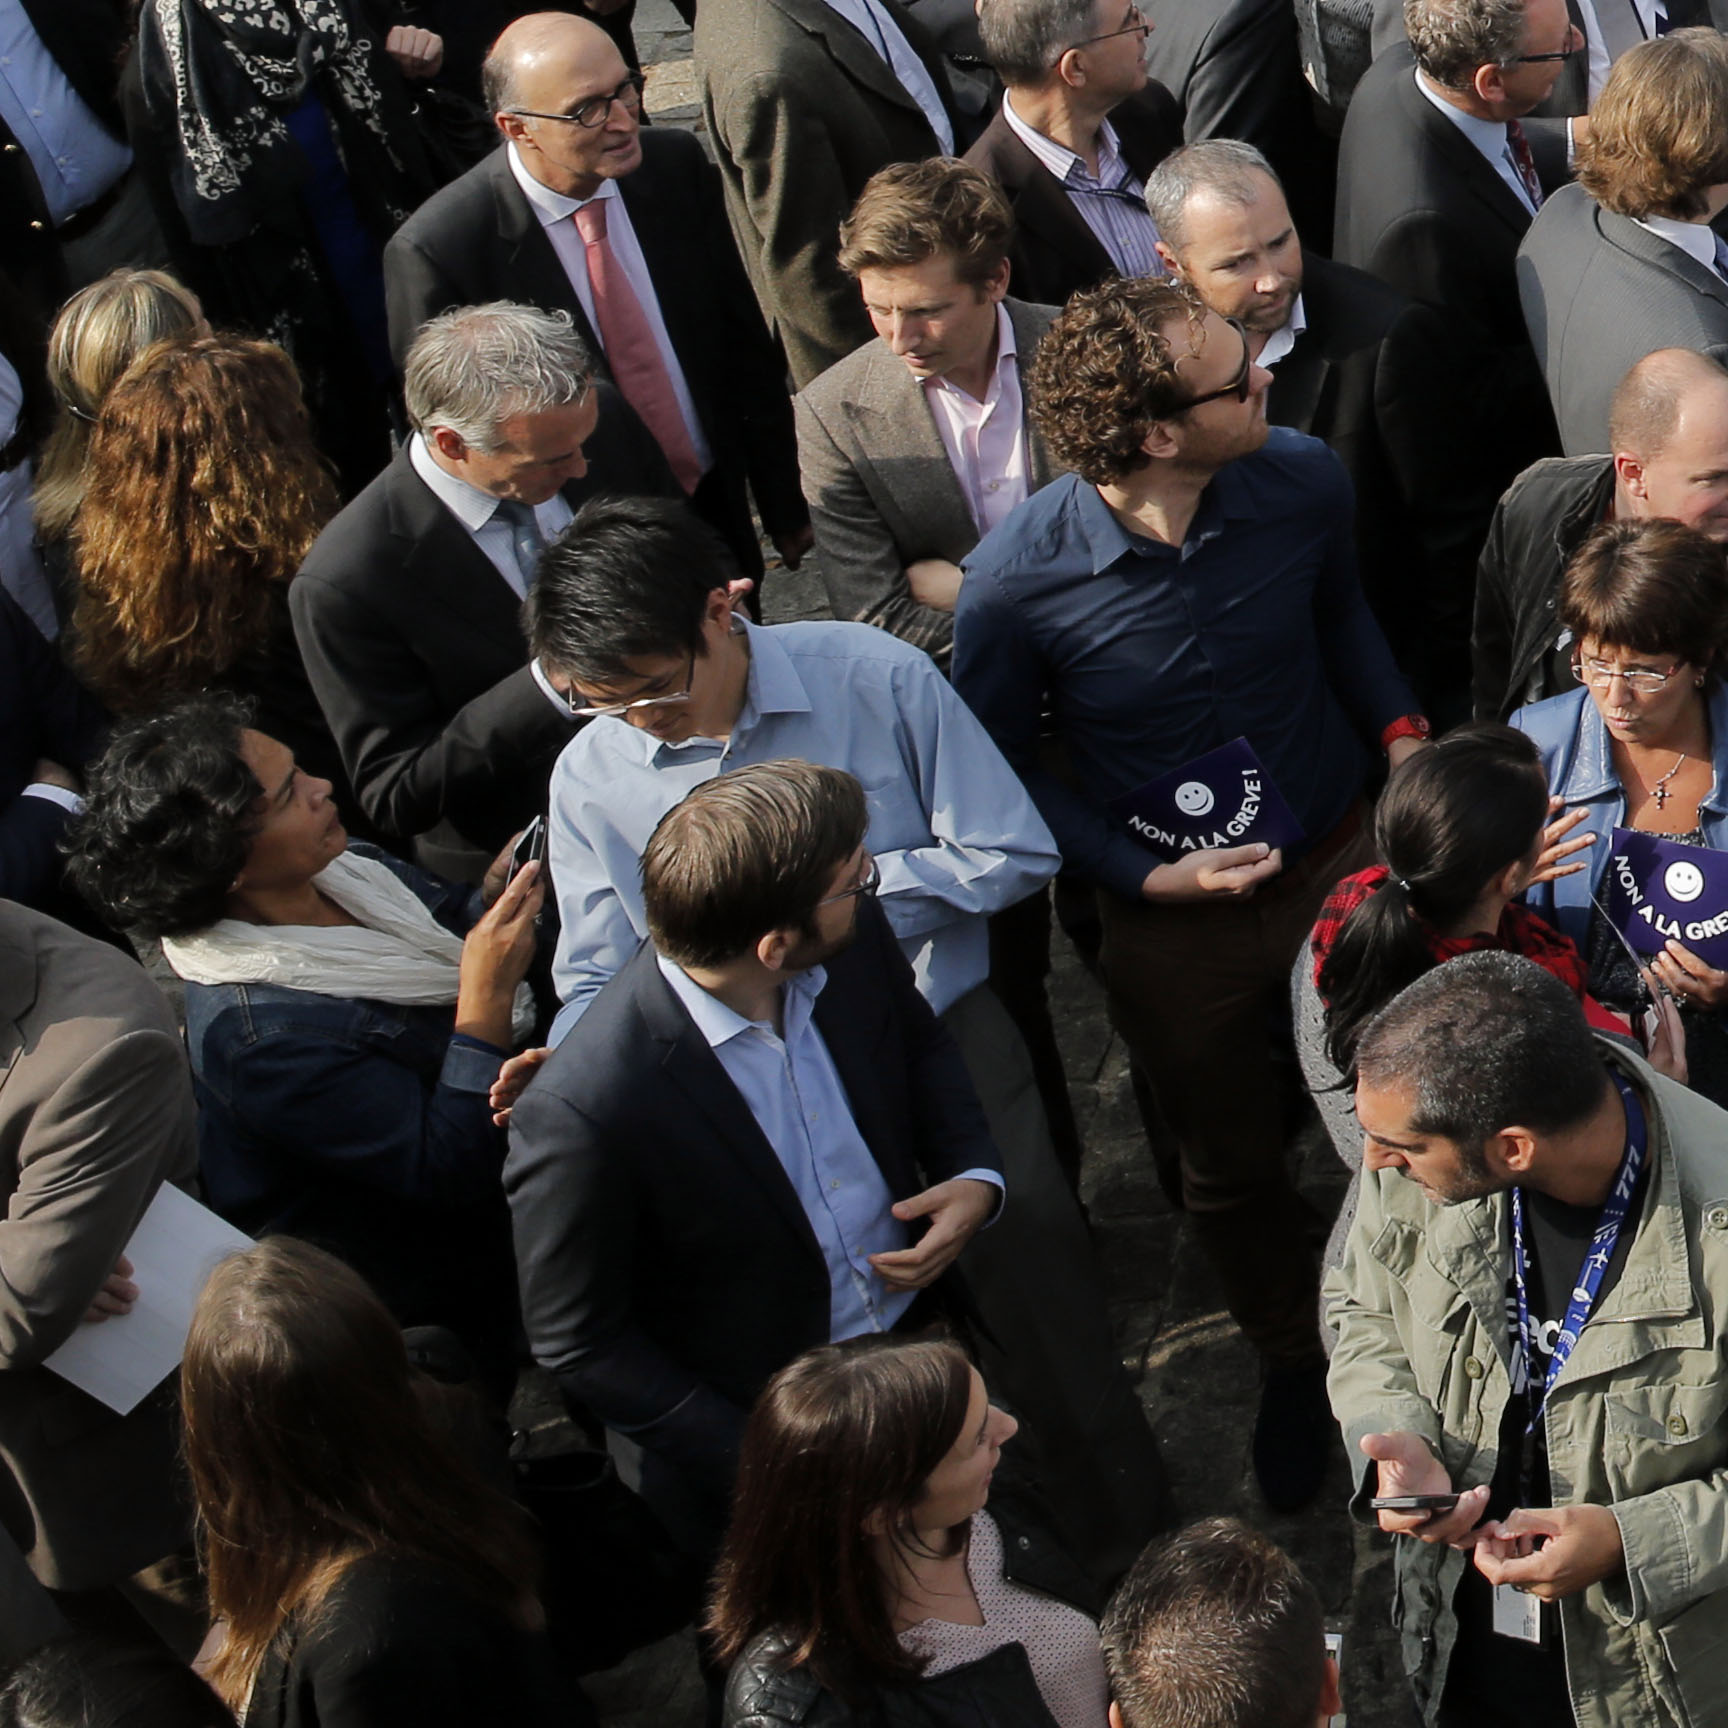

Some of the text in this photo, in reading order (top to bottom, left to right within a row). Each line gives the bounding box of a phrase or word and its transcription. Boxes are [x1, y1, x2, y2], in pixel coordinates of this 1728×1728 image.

[1128, 815, 1175, 846] NON
[1180, 836, 1197, 850] A
[1198, 831, 1229, 849] LA
[1226, 779, 1262, 837] GREVE
[1614, 855, 1644, 905] NON
[1637, 905, 1654, 924] A
[1655, 914, 1681, 940] LA
[1615, 1145, 1642, 1200] 777
